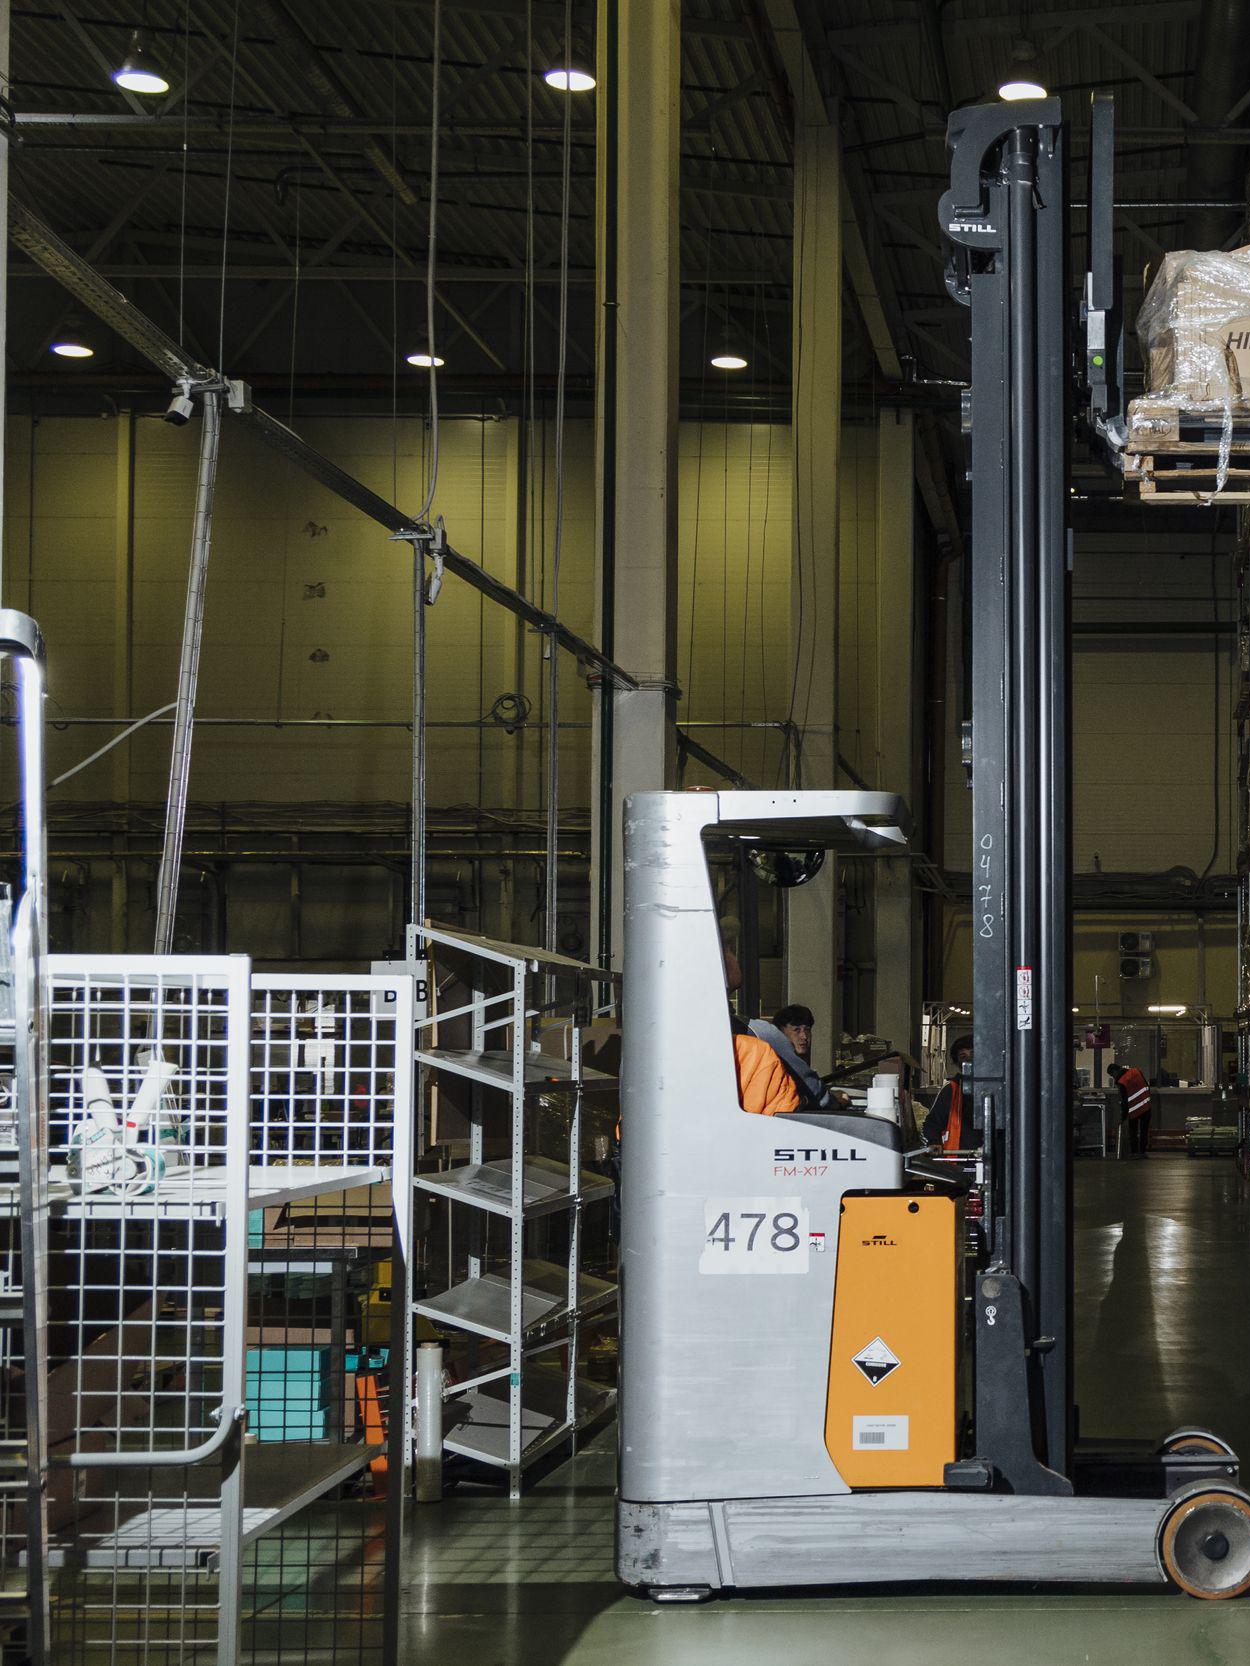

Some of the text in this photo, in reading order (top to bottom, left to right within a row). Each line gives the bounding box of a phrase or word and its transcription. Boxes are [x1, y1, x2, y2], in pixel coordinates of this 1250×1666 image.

[949, 224, 996, 232] STILL
[979, 834, 994, 937] 0478
[416, 979, 428, 1003] B
[774, 1149, 867, 1161] STILL
[774, 1166, 828, 1176] FM-X17
[706, 1212, 800, 1252] 478
